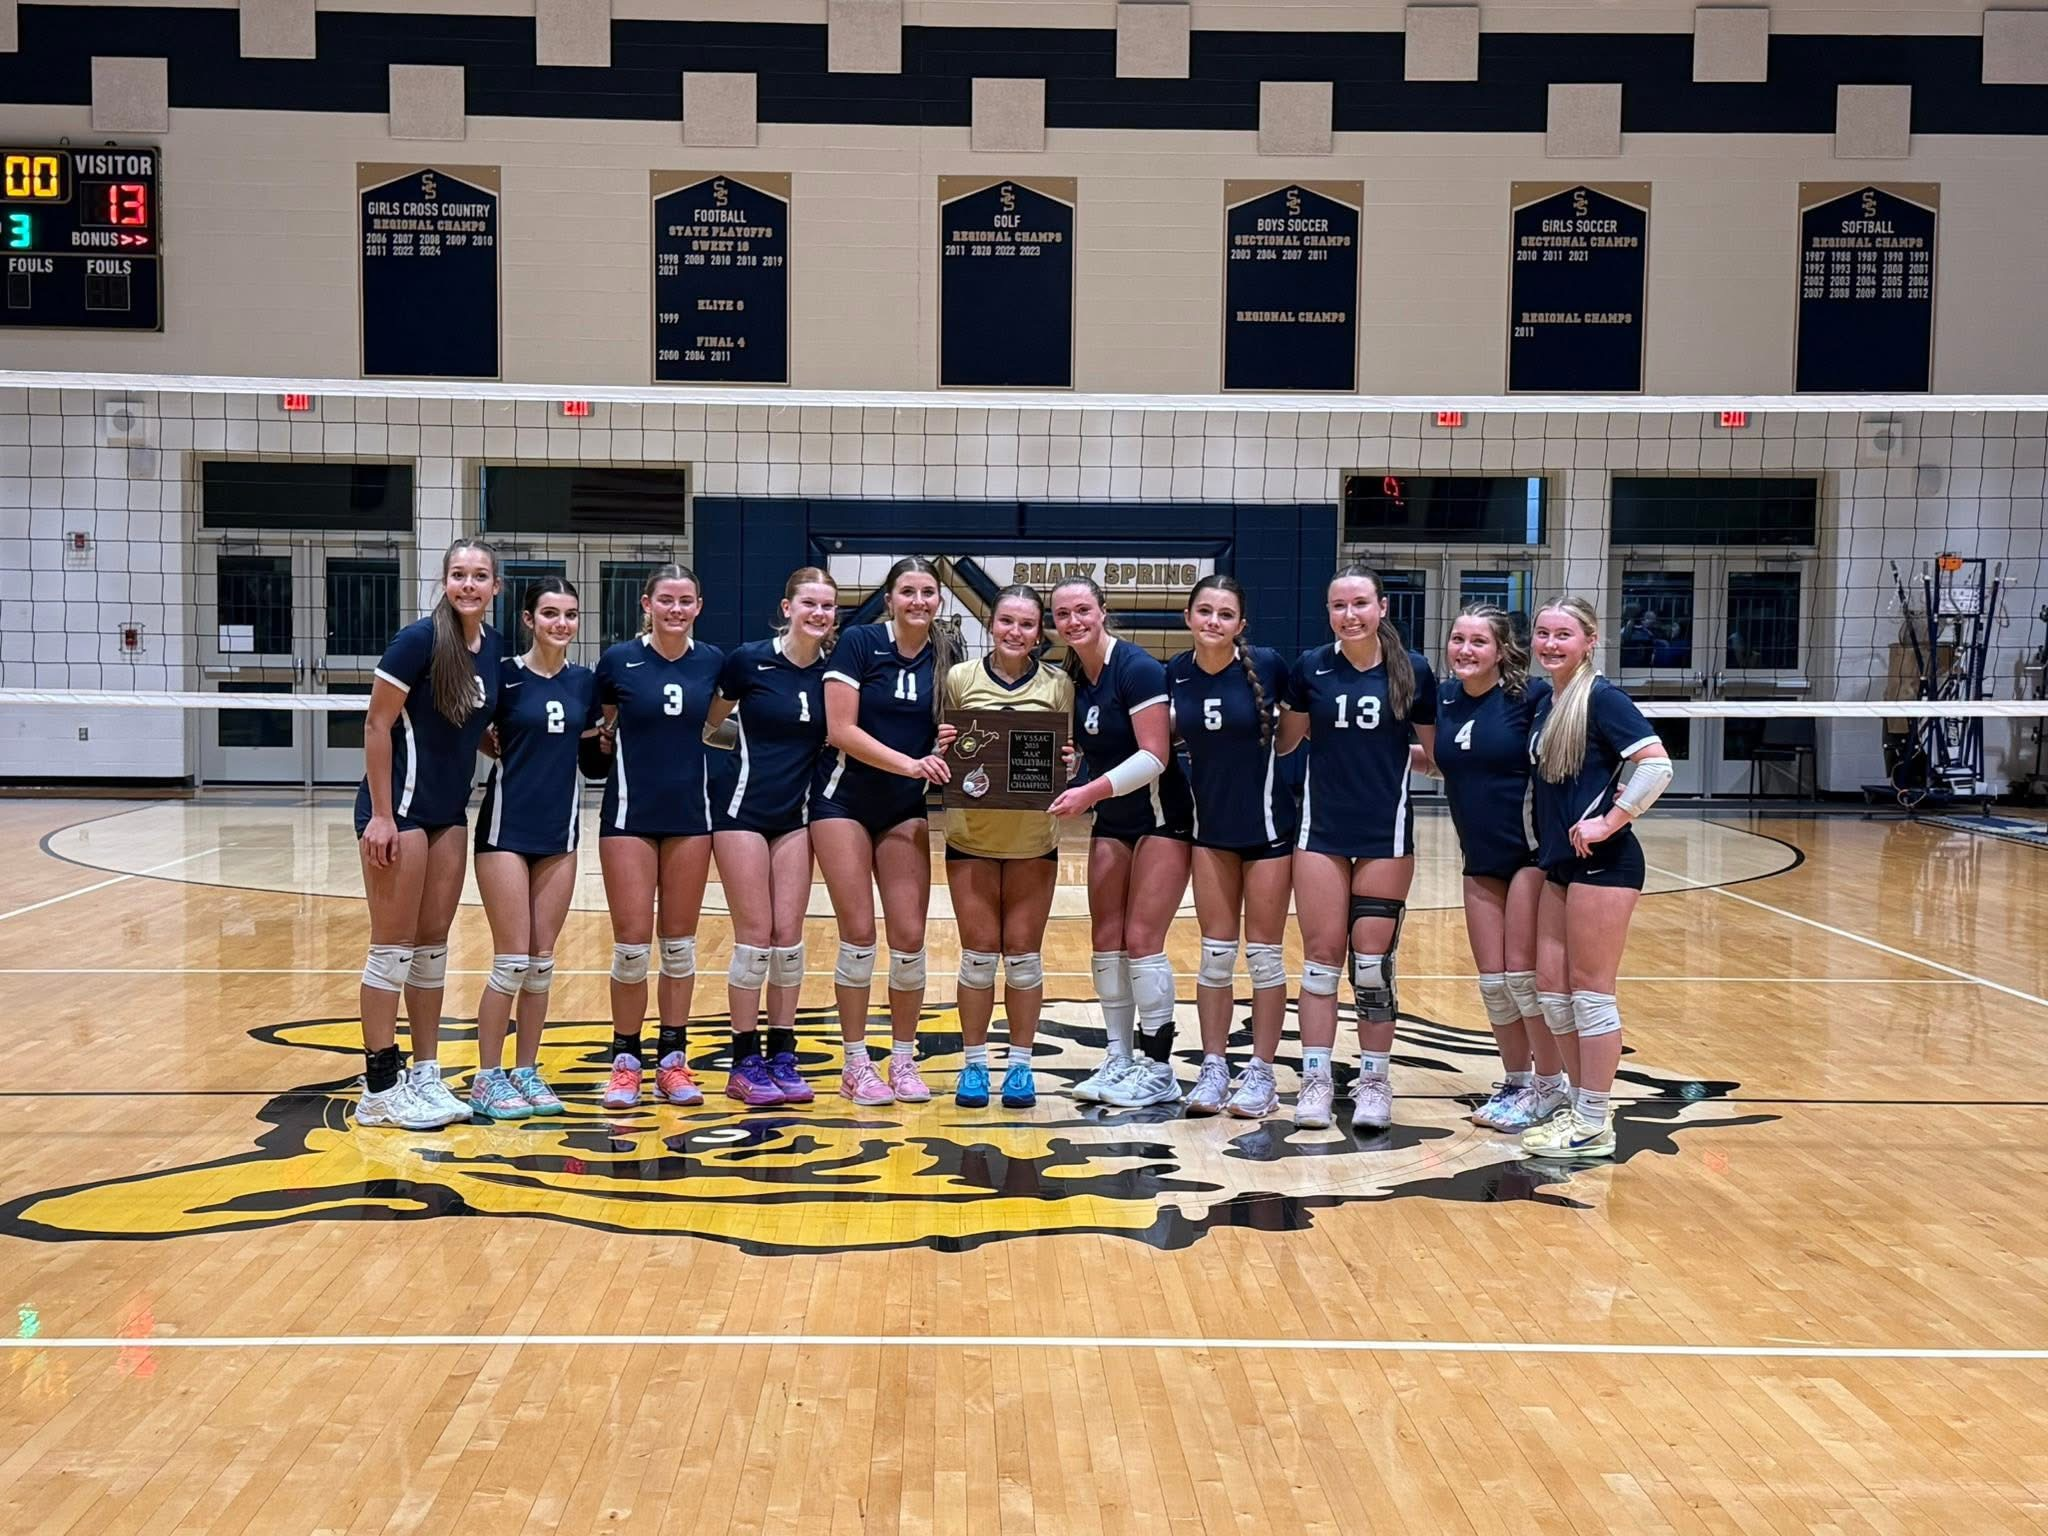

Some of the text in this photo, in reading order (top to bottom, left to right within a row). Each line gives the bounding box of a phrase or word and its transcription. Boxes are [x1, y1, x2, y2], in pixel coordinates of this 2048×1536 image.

[75, 155, 152, 175] VISITOR
[110, 185, 145, 224] 13
[368, 202, 490, 218] GIRLS CROSS COUNTRY
[694, 209, 746, 223] FOOTBALL
[994, 215, 1020, 228] GOLF
[10, 214, 30, 247] 3
[373, 219, 486, 232] REGIONAL CHAMPS
[1258, 218, 1328, 232] BOYS SOCCER
[1542, 220, 1618, 232] GIRLS SOCCER
[1842, 220, 1894, 234] SOFTBALL
[668, 226, 772, 238] STATE PLAYOFFS
[952, 231, 1062, 242] REGIONAL CHAMPS
[72, 232, 118, 246] BONUS
[392, 234, 413, 244] 2007
[446, 235, 466, 246] 2009
[472, 236, 493, 246] 2010
[1234, 235, 1350, 246] SECTIONAL CHAMPS
[1521, 236, 1638, 247] SECTIONAL CHAMPS
[1812, 237, 1923, 248] REGIONAL CHAMPS
[366, 246, 440, 256] 2011 2022 2024
[692, 240, 734, 251] SWEET
[945, 246, 965, 256] 2011
[995, 246, 1016, 256] 2022
[1020, 246, 1040, 256] 2023
[762, 256, 782, 266] 2019
[1282, 250, 1302, 260] 2007
[1308, 250, 1328, 260] 2011
[1517, 250, 1588, 261] 2010 2011 2021
[1910, 252, 1928, 262] 1991
[8, 258, 54, 272] FOULS
[86, 260, 132, 274] FOULS
[658, 266, 678, 276] 2021
[1805, 264, 1824, 274] 1992
[1908, 288, 1928, 298] 2012
[698, 300, 734, 310] ELITE
[659, 313, 679, 324] 1999
[1236, 312, 1346, 322] REGIONAL CHAMPS
[1522, 313, 1632, 324] REGIONAL CHAMPS
[1514, 326, 1534, 336] 2011
[697, 336, 746, 348] FINAL 4
[711, 351, 730, 361] 2011
[1014, 562, 1197, 585] SHADY SPRING
[894, 669, 918, 702] 11
[664, 684, 683, 716] 3
[798, 692, 811, 722] 1
[1335, 694, 1381, 730] 13
[546, 700, 564, 733] 2
[1084, 705, 1100, 735] 8
[1204, 698, 1222, 730] 5
[1454, 720, 1476, 750] 4
[1011, 758, 1050, 766] VOLLEYBALL
[1012, 774, 1048, 782] REGIONAL
[1010, 781, 1050, 790] CHAMPION
